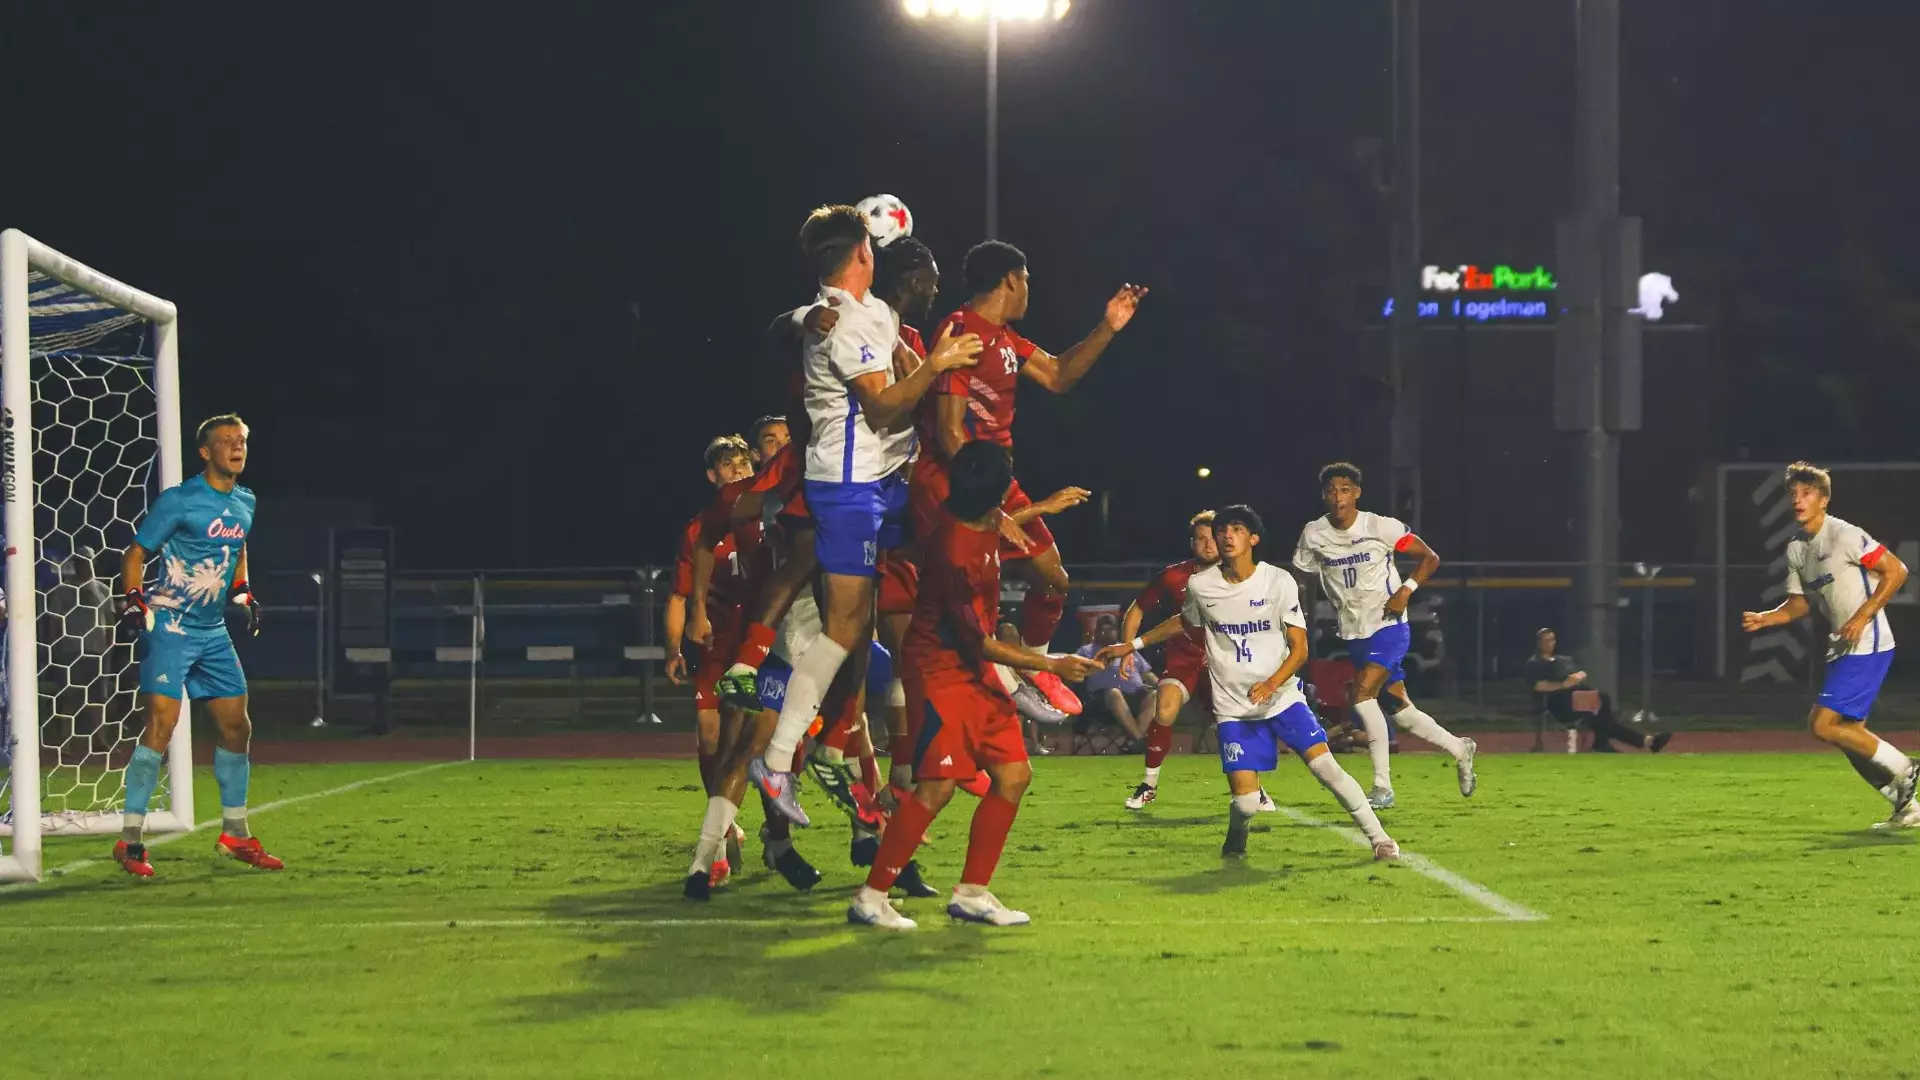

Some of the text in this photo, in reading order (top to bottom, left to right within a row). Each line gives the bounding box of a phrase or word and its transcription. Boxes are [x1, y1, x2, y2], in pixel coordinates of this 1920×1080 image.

[207, 517, 246, 538] Owls
[1342, 567, 1358, 589] 10
[1234, 638, 1253, 663] 14
